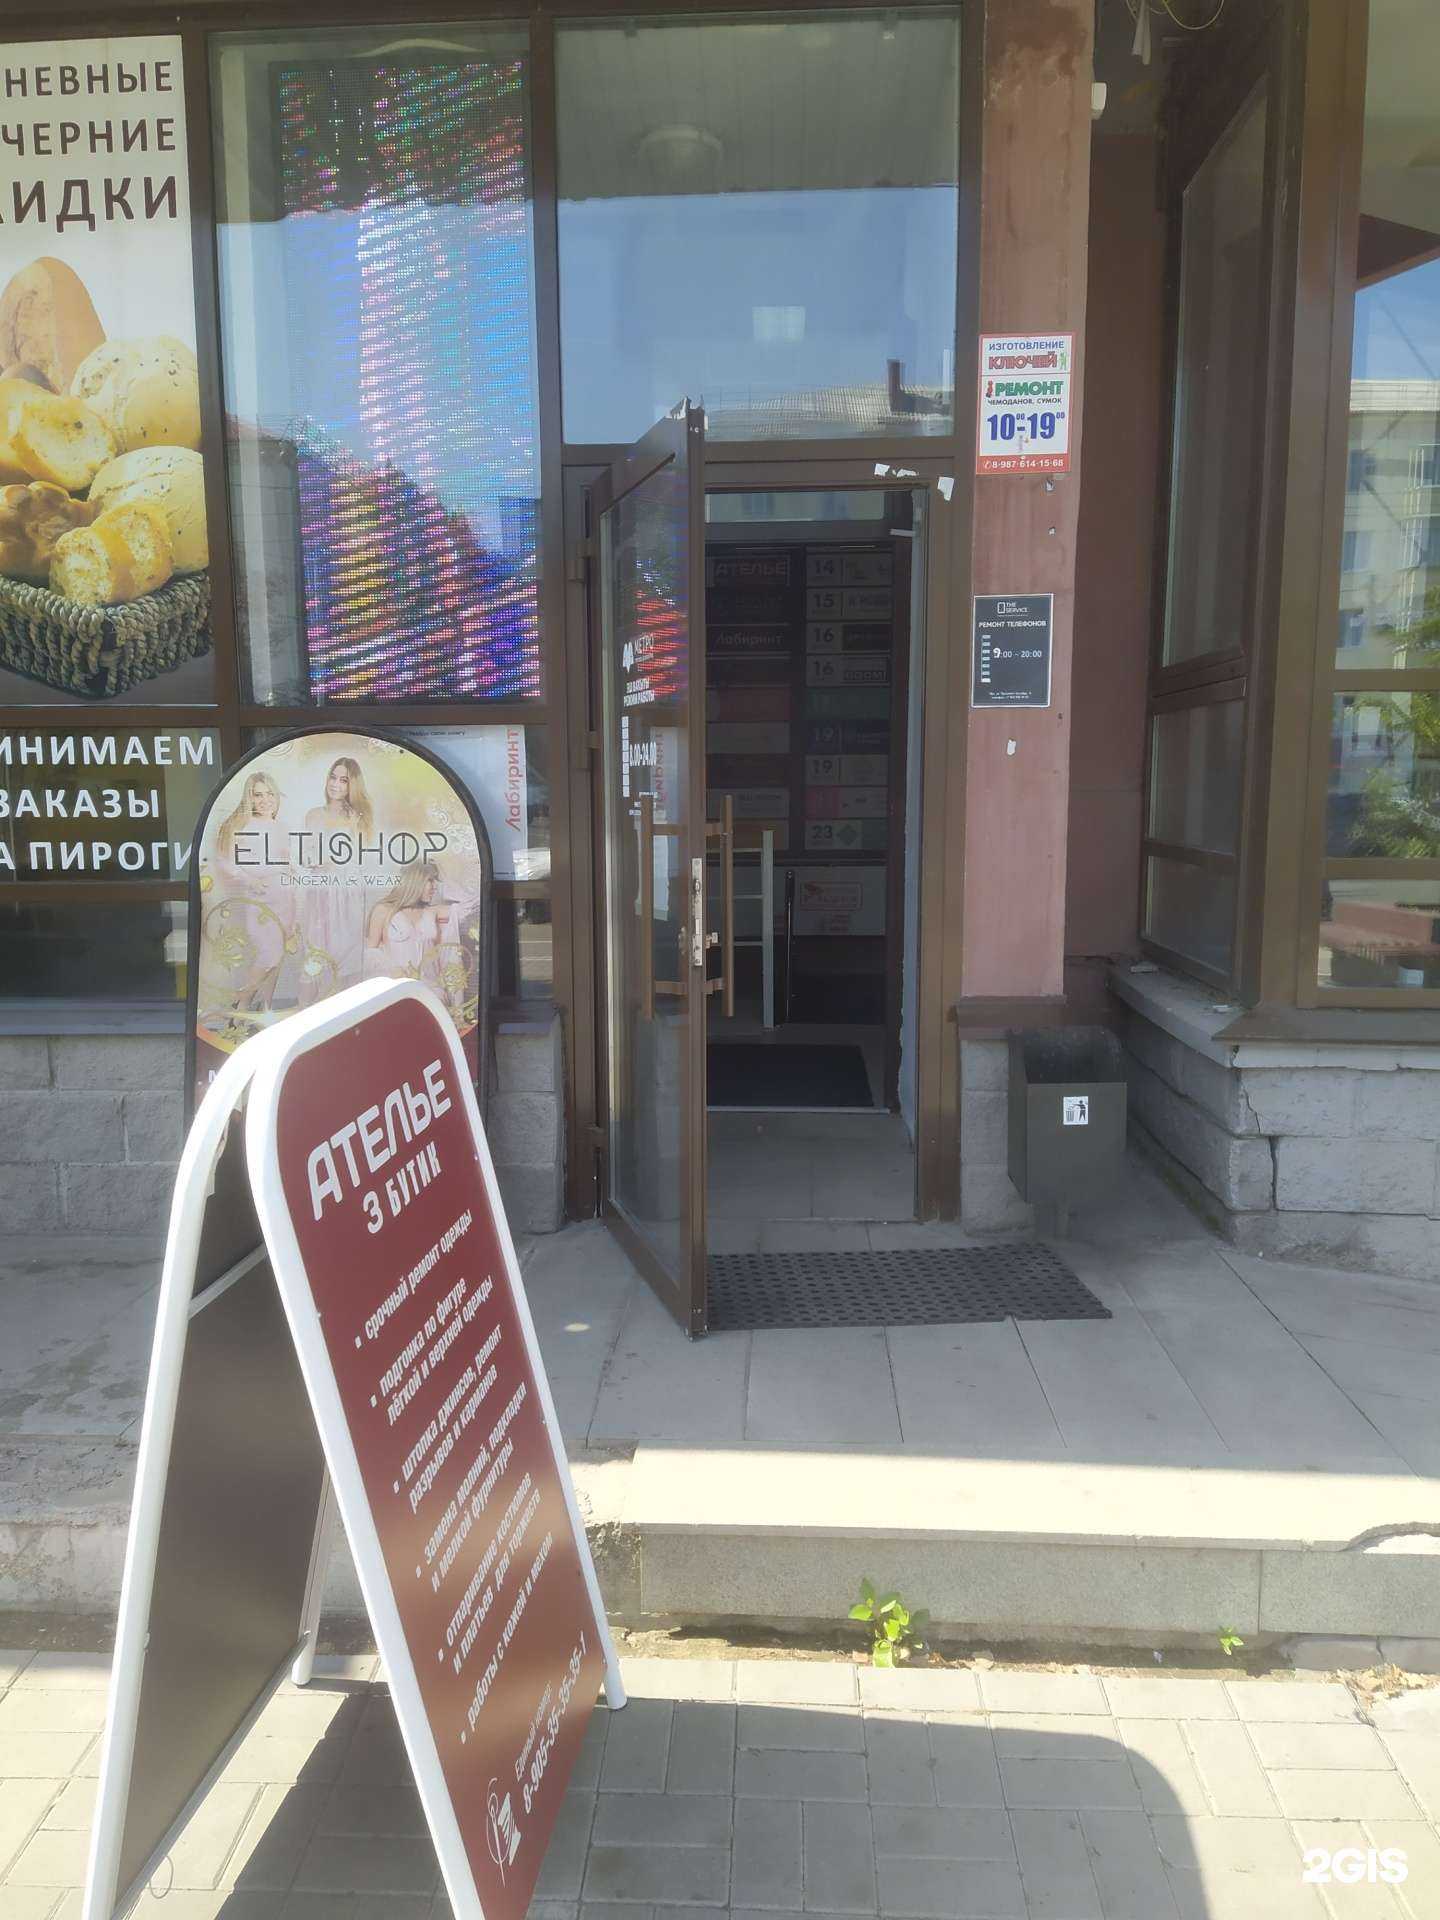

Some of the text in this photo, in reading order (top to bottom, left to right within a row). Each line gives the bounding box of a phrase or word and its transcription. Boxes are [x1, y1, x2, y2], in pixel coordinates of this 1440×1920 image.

[5, 61, 173, 97] НЕВНЫЕ
[1, 118, 176, 156] ЧЕРНИЕ
[0, 176, 177, 233] ИДКИ
[988, 351, 1057, 369] КЛЮЧЕЙ
[989, 341, 1065, 351] ИЗГОТОВЛЕНИЕ
[995, 381, 1064, 396] РЕМОНТ
[814, 594, 834, 608] 15
[815, 560, 834, 575] 14
[814, 628, 834, 642] 16
[814, 661, 834, 676] 16
[1021, 650, 1042, 658] 20:00
[505, 728, 524, 832] Лабиринт
[234, 831, 448, 866] ELTISHOP
[811, 825, 833, 839] 23
[307, 1059, 452, 1221] АТЕЛЬЕ
[385, 1141, 442, 1217] БУТИК
[365, 1209, 473, 1340] срочный ремонт одежды
[379, 1278, 467, 1397] подгонка по фигуре
[387, 1275, 493, 1426] лёгкой и верхней одежды
[401, 1324, 502, 1482] штопка джинсов, ремонт
[409, 1364, 498, 1515] разрывов и карманов
[425, 1500, 458, 1565] замена
[488, 1381, 527, 1451] подкладки
[431, 1437, 514, 1593] и мелкой фурнитуры
[446, 1472, 532, 1647] отпаривание костюмов
[453, 1652, 462, 1676] и
[460, 1585, 494, 1658] платьев
[494, 1551, 511, 1592] для
[467, 1654, 498, 1732] работы
[496, 1641, 504, 1660] с
[502, 1585, 527, 1648] кожей
[525, 1576, 533, 1596] и
[523, 1630, 587, 1815] 8-905-35-35-35-1
